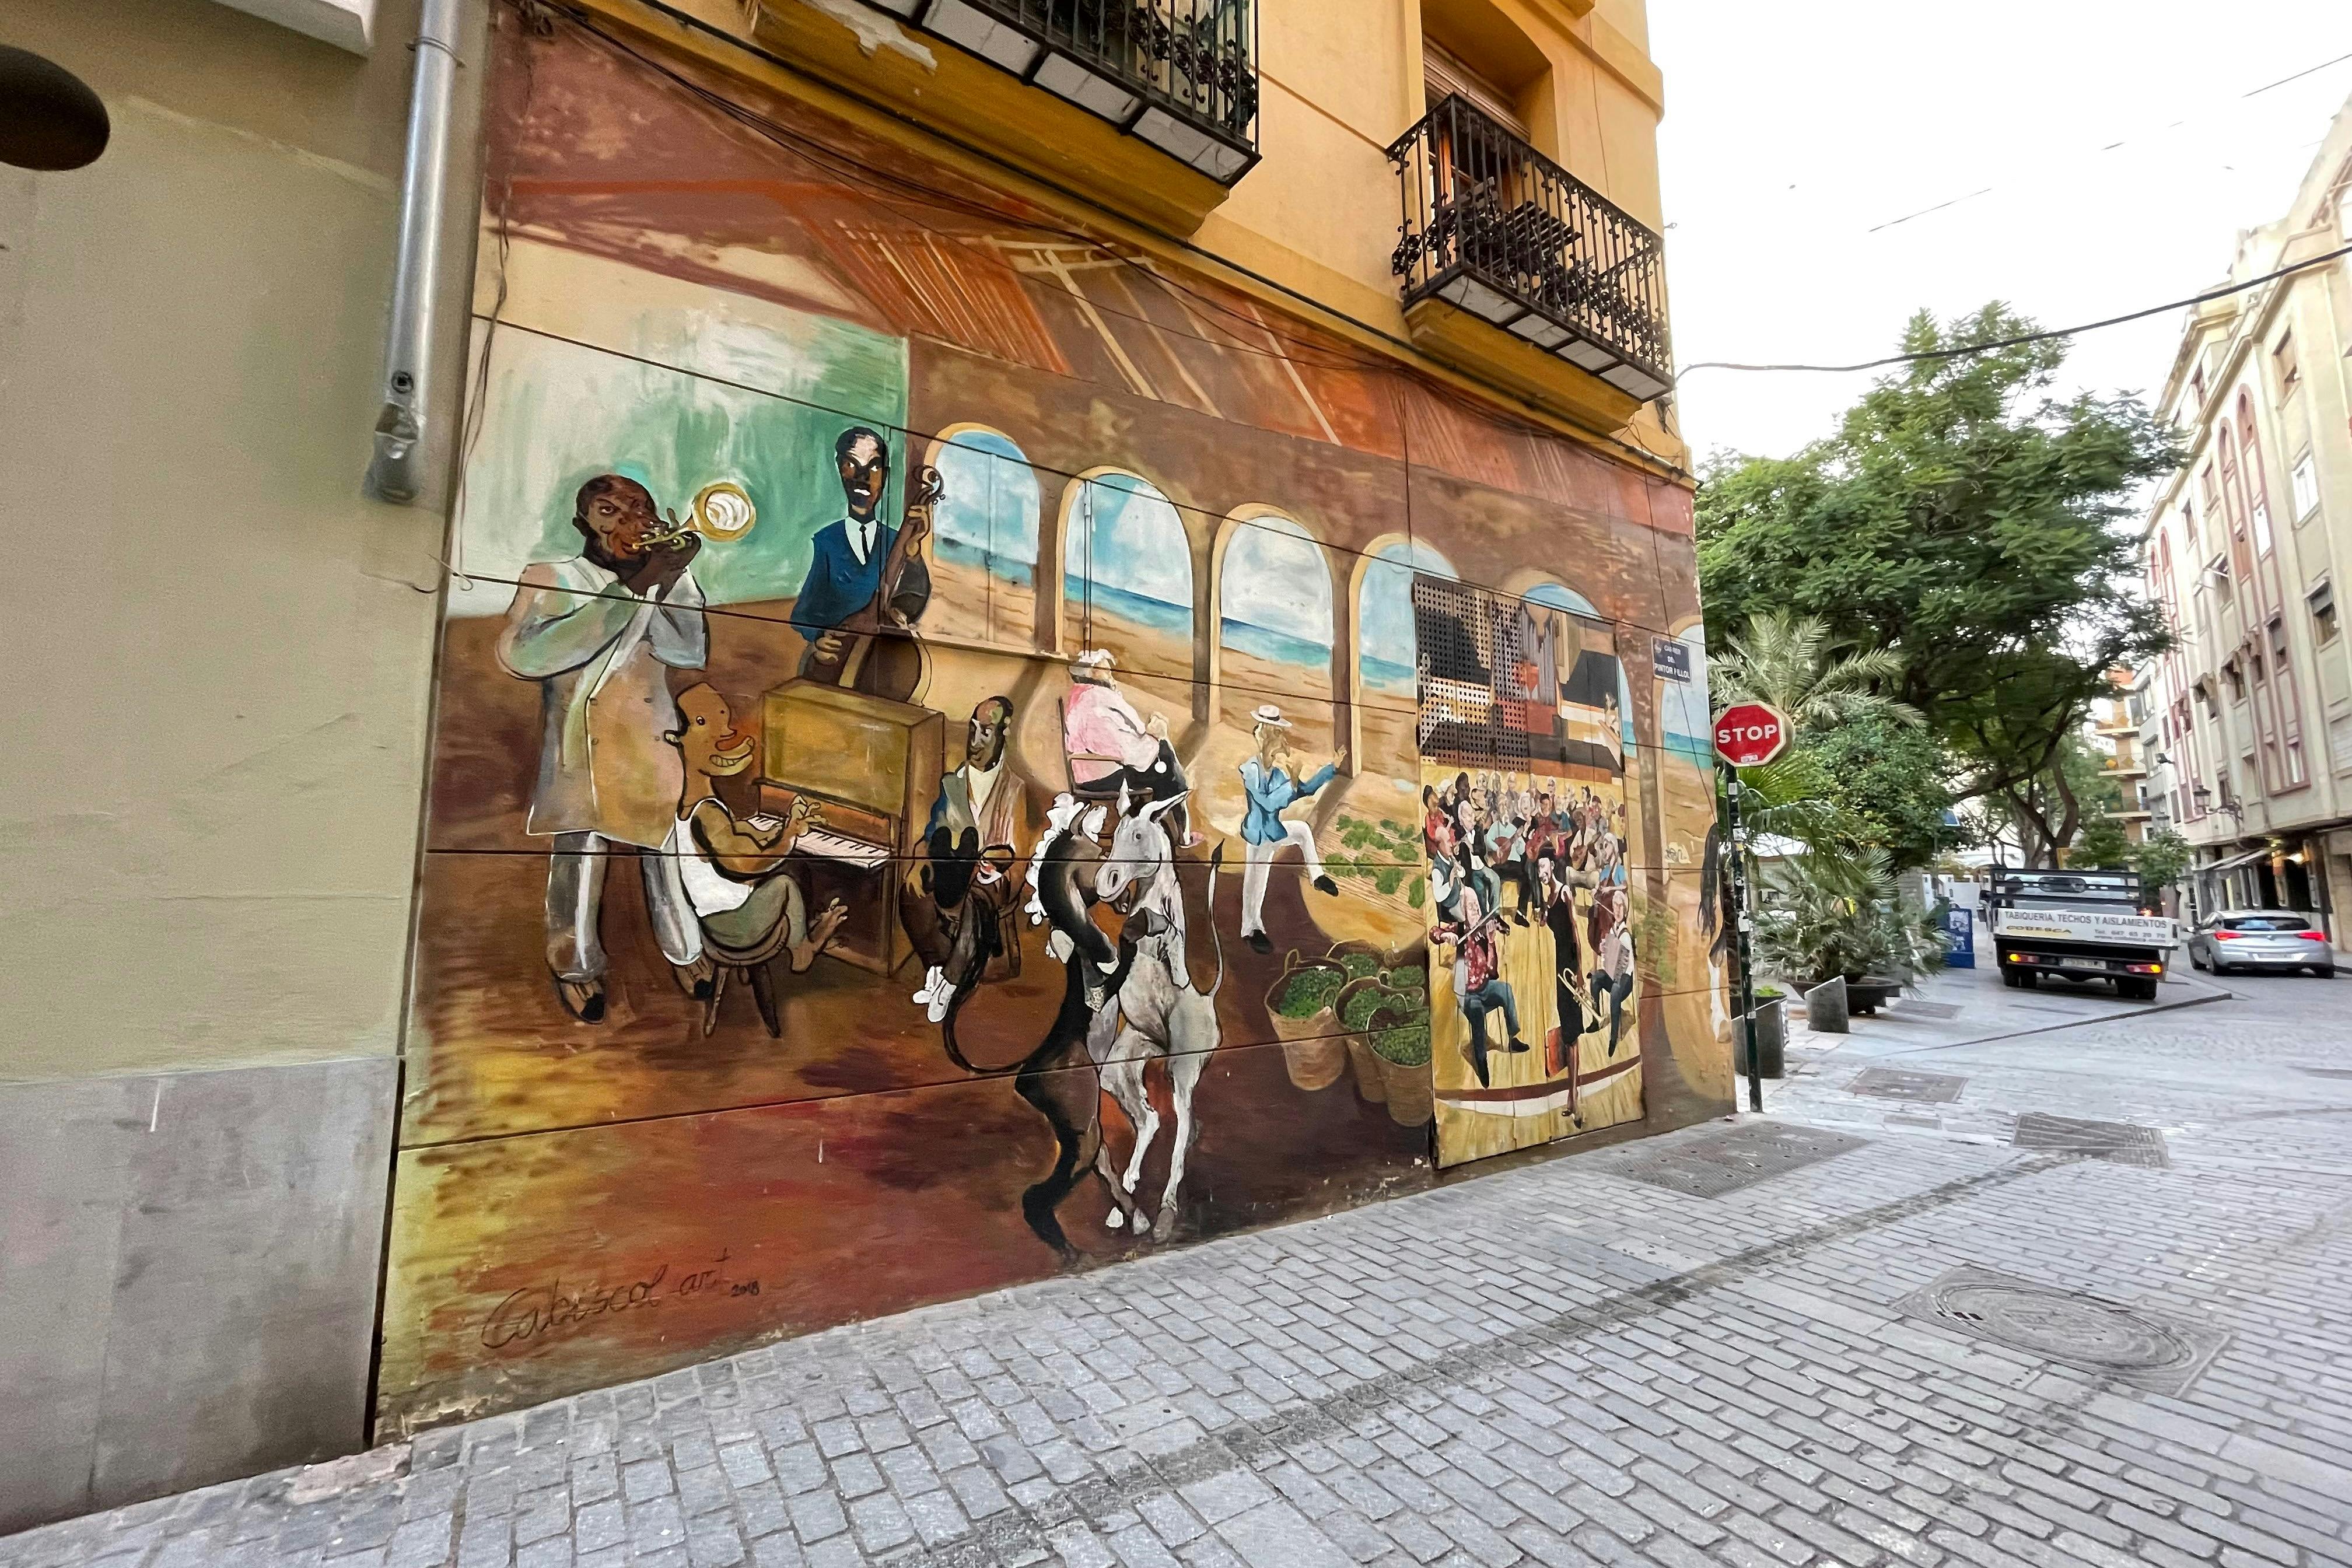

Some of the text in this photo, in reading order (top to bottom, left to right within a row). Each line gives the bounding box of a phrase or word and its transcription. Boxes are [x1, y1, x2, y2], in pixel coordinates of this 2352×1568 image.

[1718, 724, 1777, 744] STOP
[2057, 914, 2091, 923] TECHOS
[2102, 917, 2166, 928] AISLAMIENTOS
